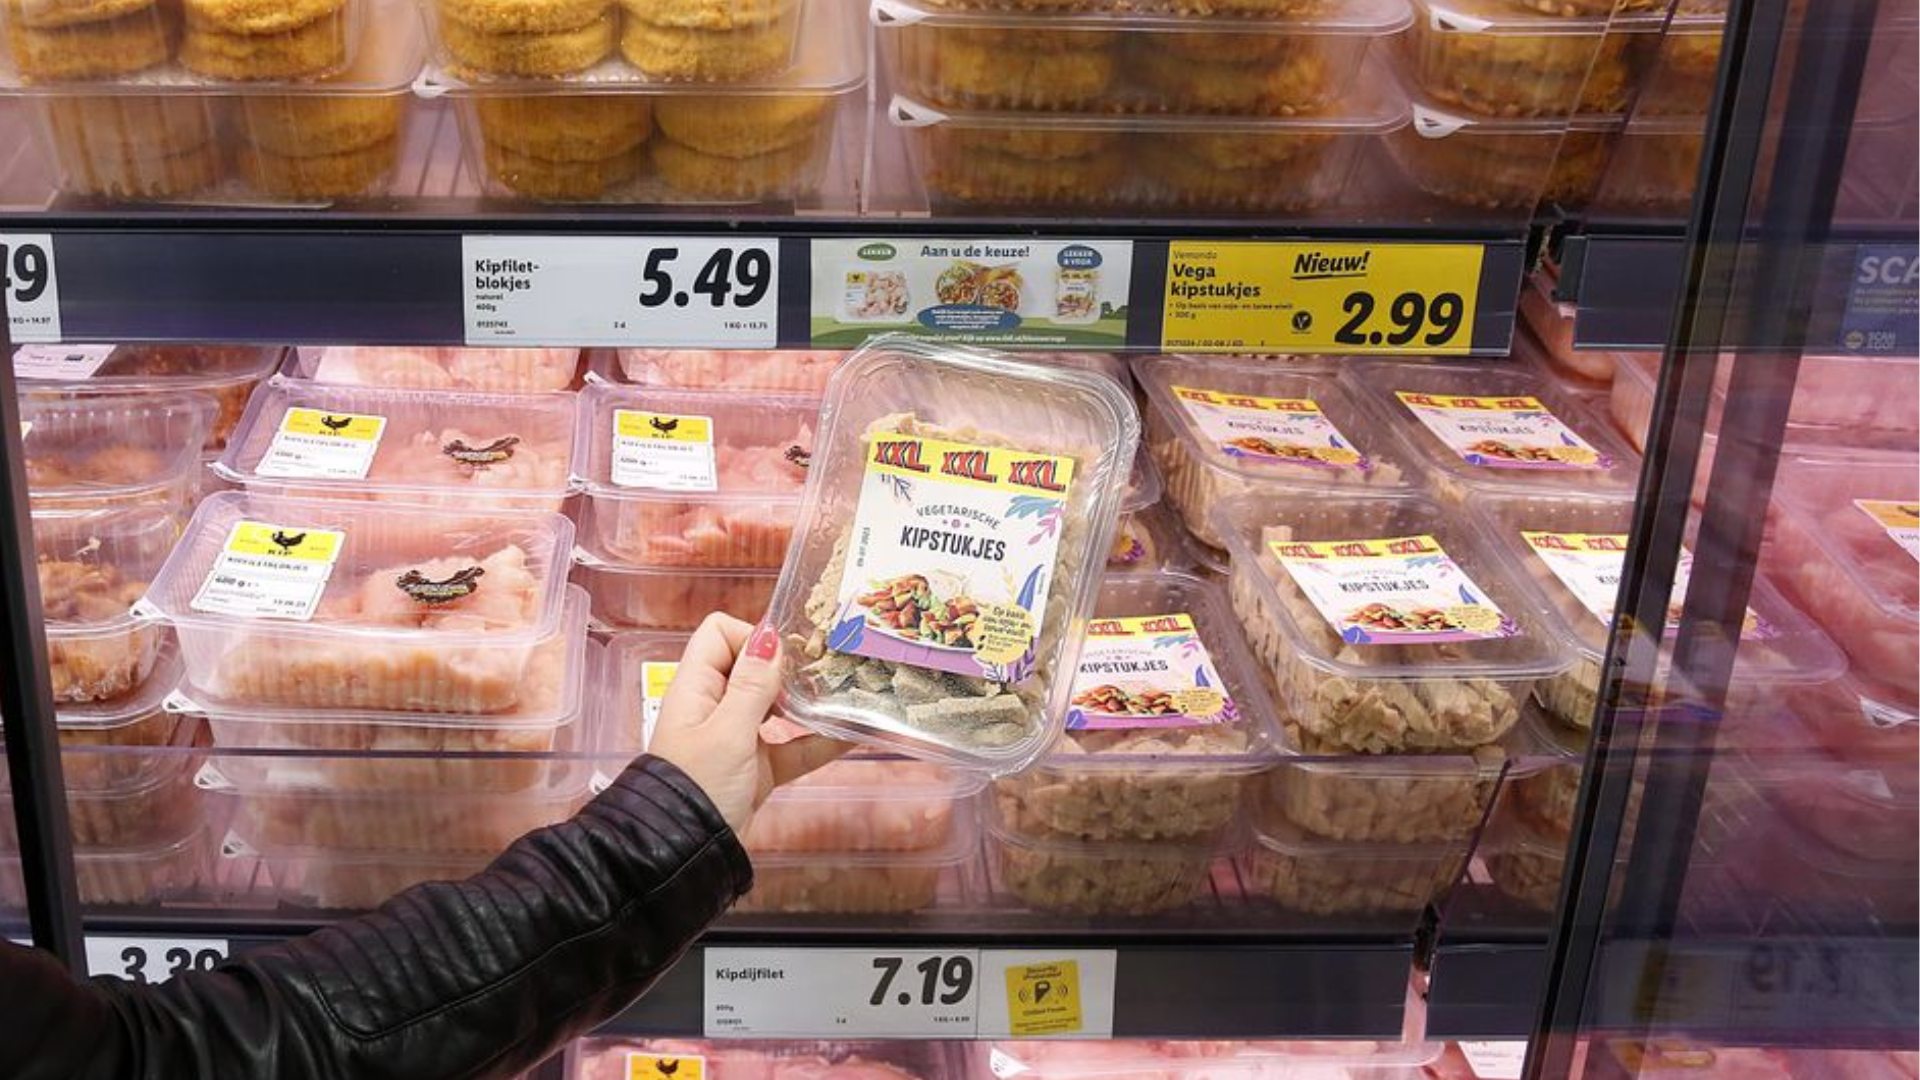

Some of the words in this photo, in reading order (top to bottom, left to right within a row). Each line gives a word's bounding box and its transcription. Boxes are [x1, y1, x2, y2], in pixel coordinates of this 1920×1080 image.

[921, 246, 948, 257] Aan
[951, 247, 960, 257] u
[964, 246, 982, 257] de
[985, 246, 1030, 257] keuze!
[1293, 251, 1370, 273] Nieuw!
[0, 244, 48, 302] 9
[476, 259, 540, 275] Kipfilet-
[639, 248, 771, 307] 5.49
[1173, 263, 1216, 281] Vega
[476, 276, 531, 292] blokjes
[1171, 281, 1261, 300] kipstukjes
[1334, 291, 1464, 346] 2.99
[874, 440, 931, 473] XXL
[941, 450, 998, 483] XXL
[1008, 460, 1067, 493] XXL
[916, 504, 1001, 530] VEGETARISCHE
[900, 525, 1006, 562] KIPSTUKJES
[716, 968, 785, 982] Kipdijfilet
[869, 956, 973, 1006] 7.19
